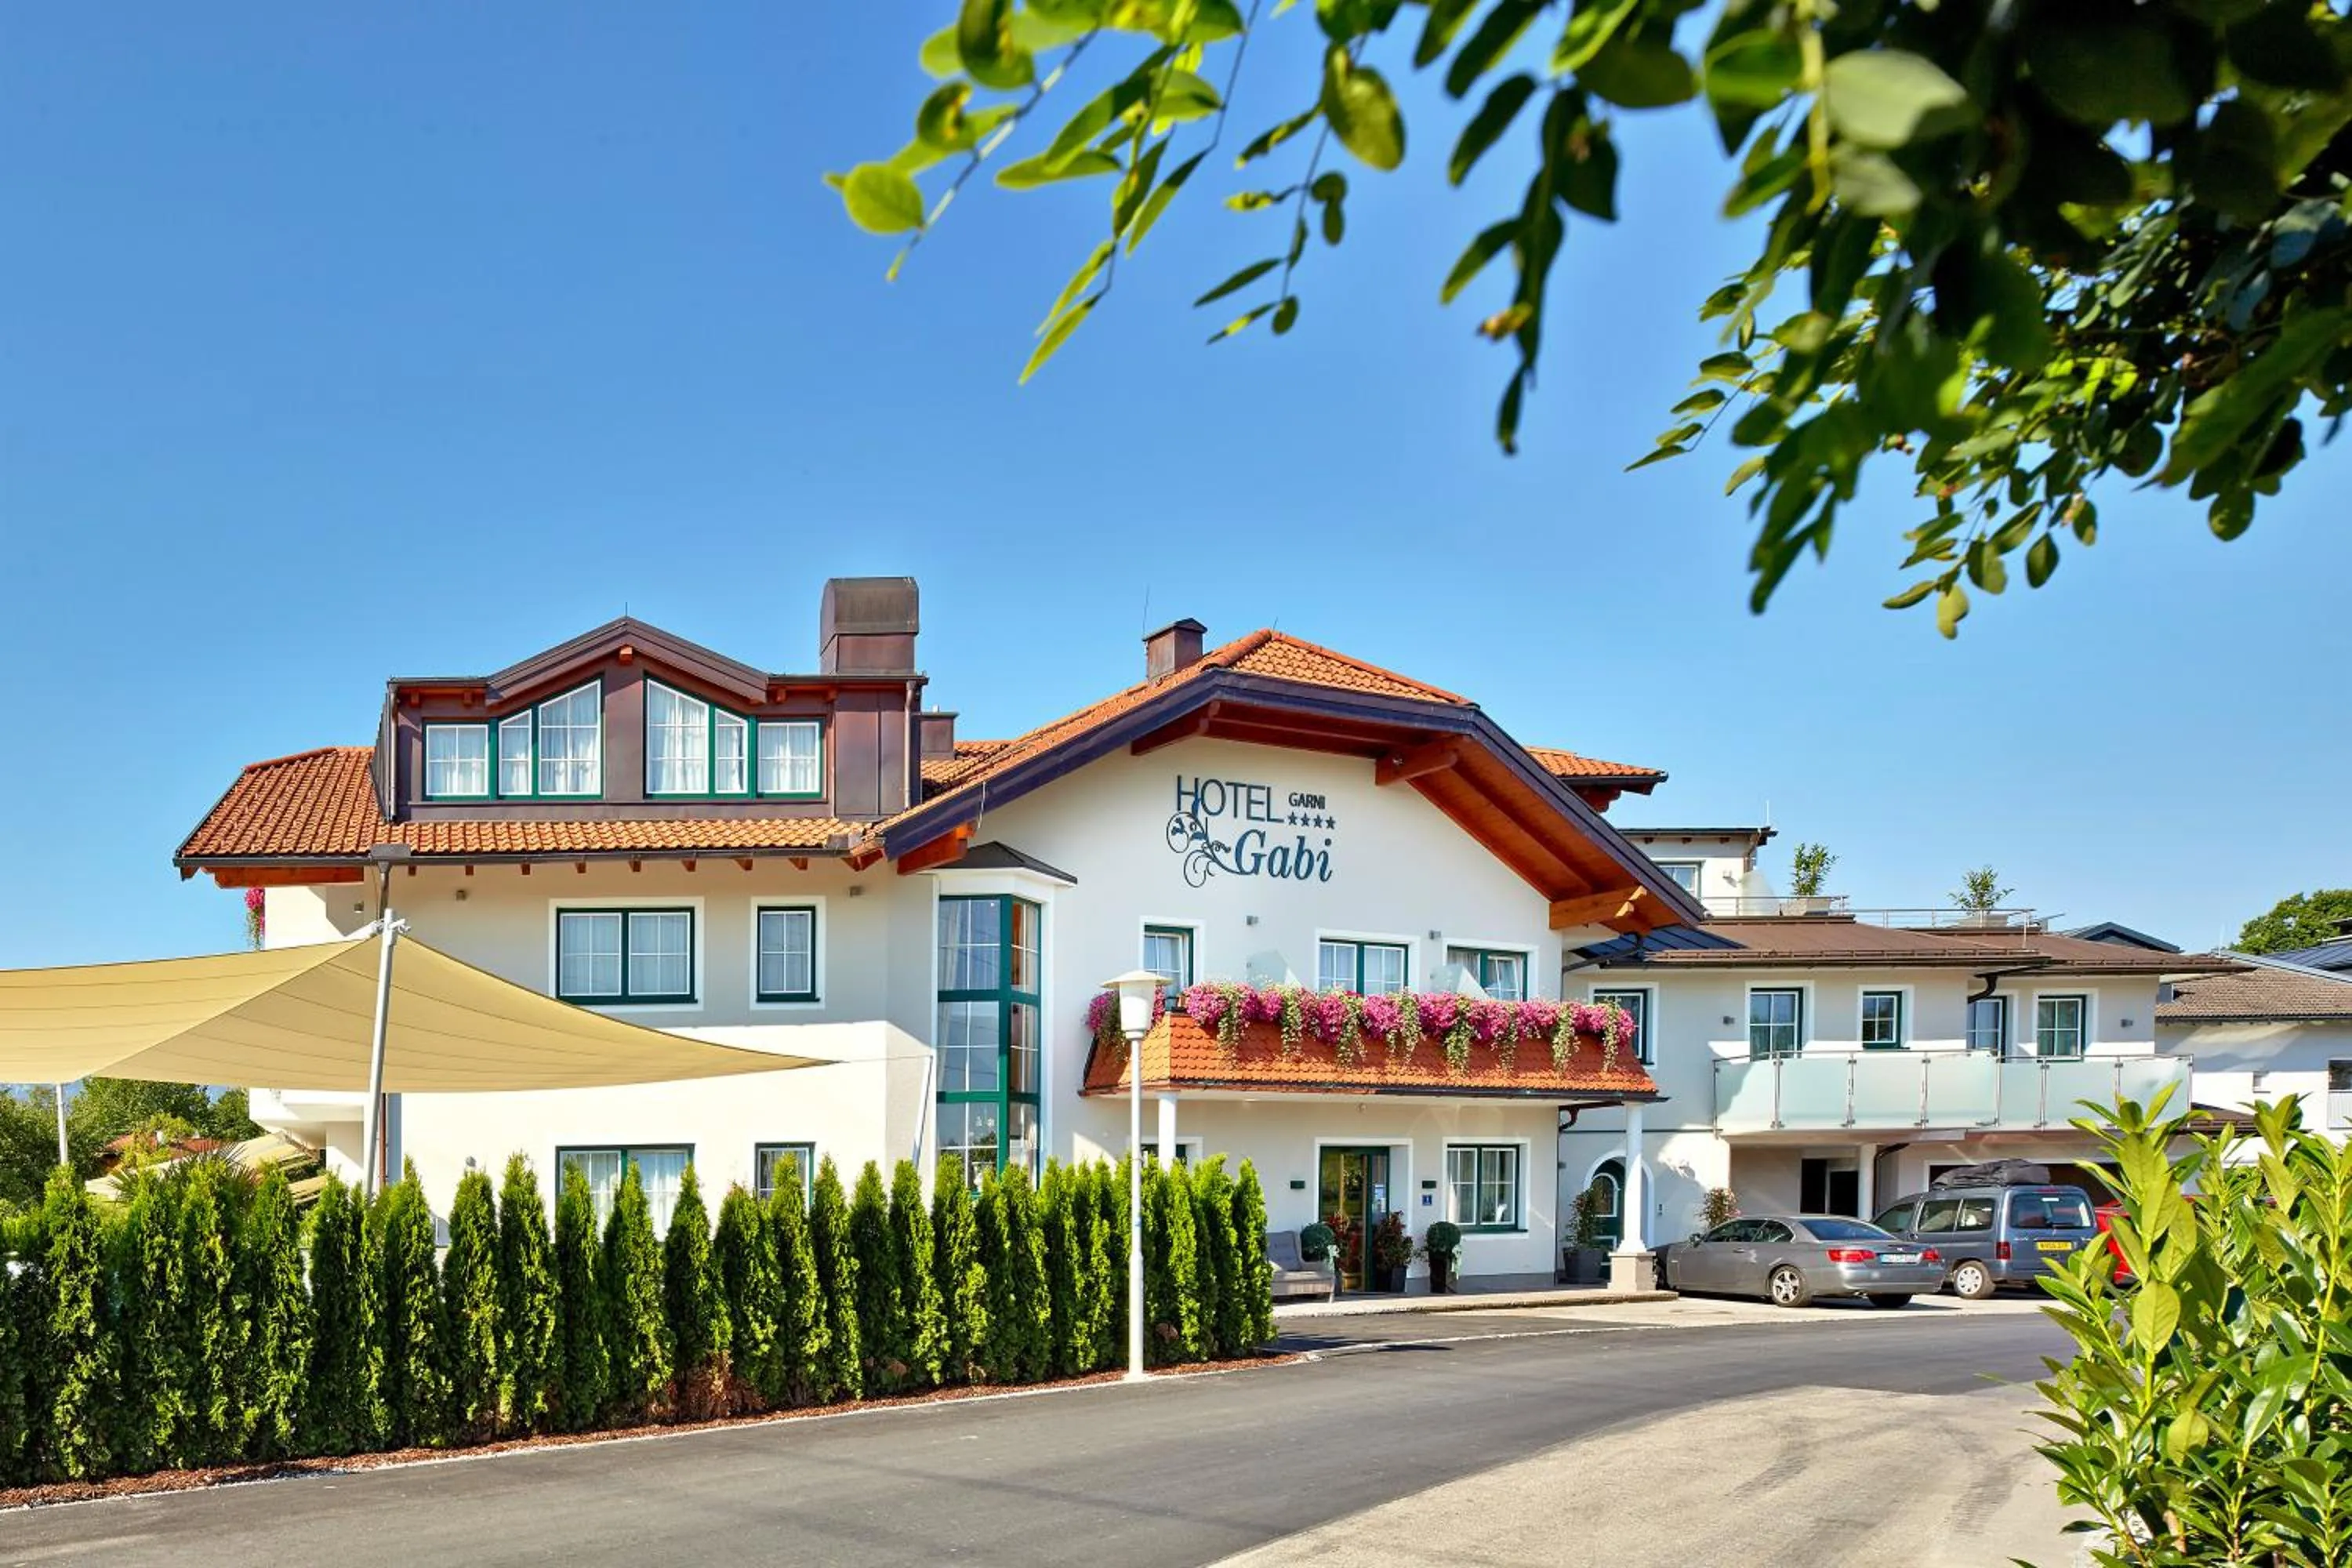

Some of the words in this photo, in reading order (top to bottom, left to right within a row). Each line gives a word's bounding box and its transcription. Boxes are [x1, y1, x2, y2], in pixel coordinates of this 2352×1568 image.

[1177, 775, 1284, 823] HOTEL
[1288, 792, 1326, 810] GARNI
[1235, 829, 1332, 882] Gabi
